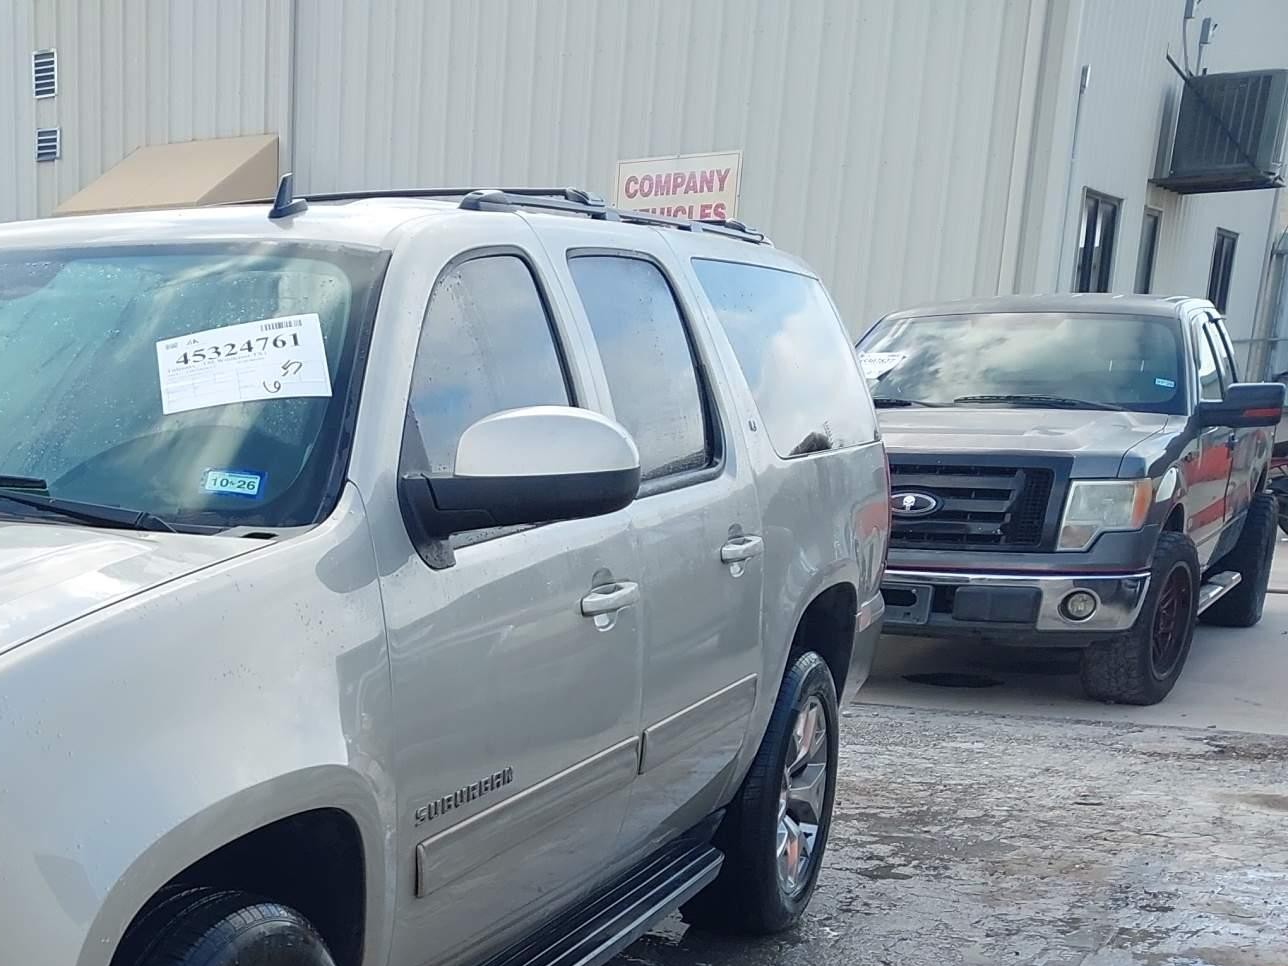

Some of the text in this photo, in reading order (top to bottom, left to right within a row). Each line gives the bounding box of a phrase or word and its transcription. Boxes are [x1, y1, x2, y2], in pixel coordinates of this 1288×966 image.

[624, 167, 731, 199] COMPANY
[175, 332, 300, 365] 45324761
[414, 765, 514, 828] SUBURBAN
